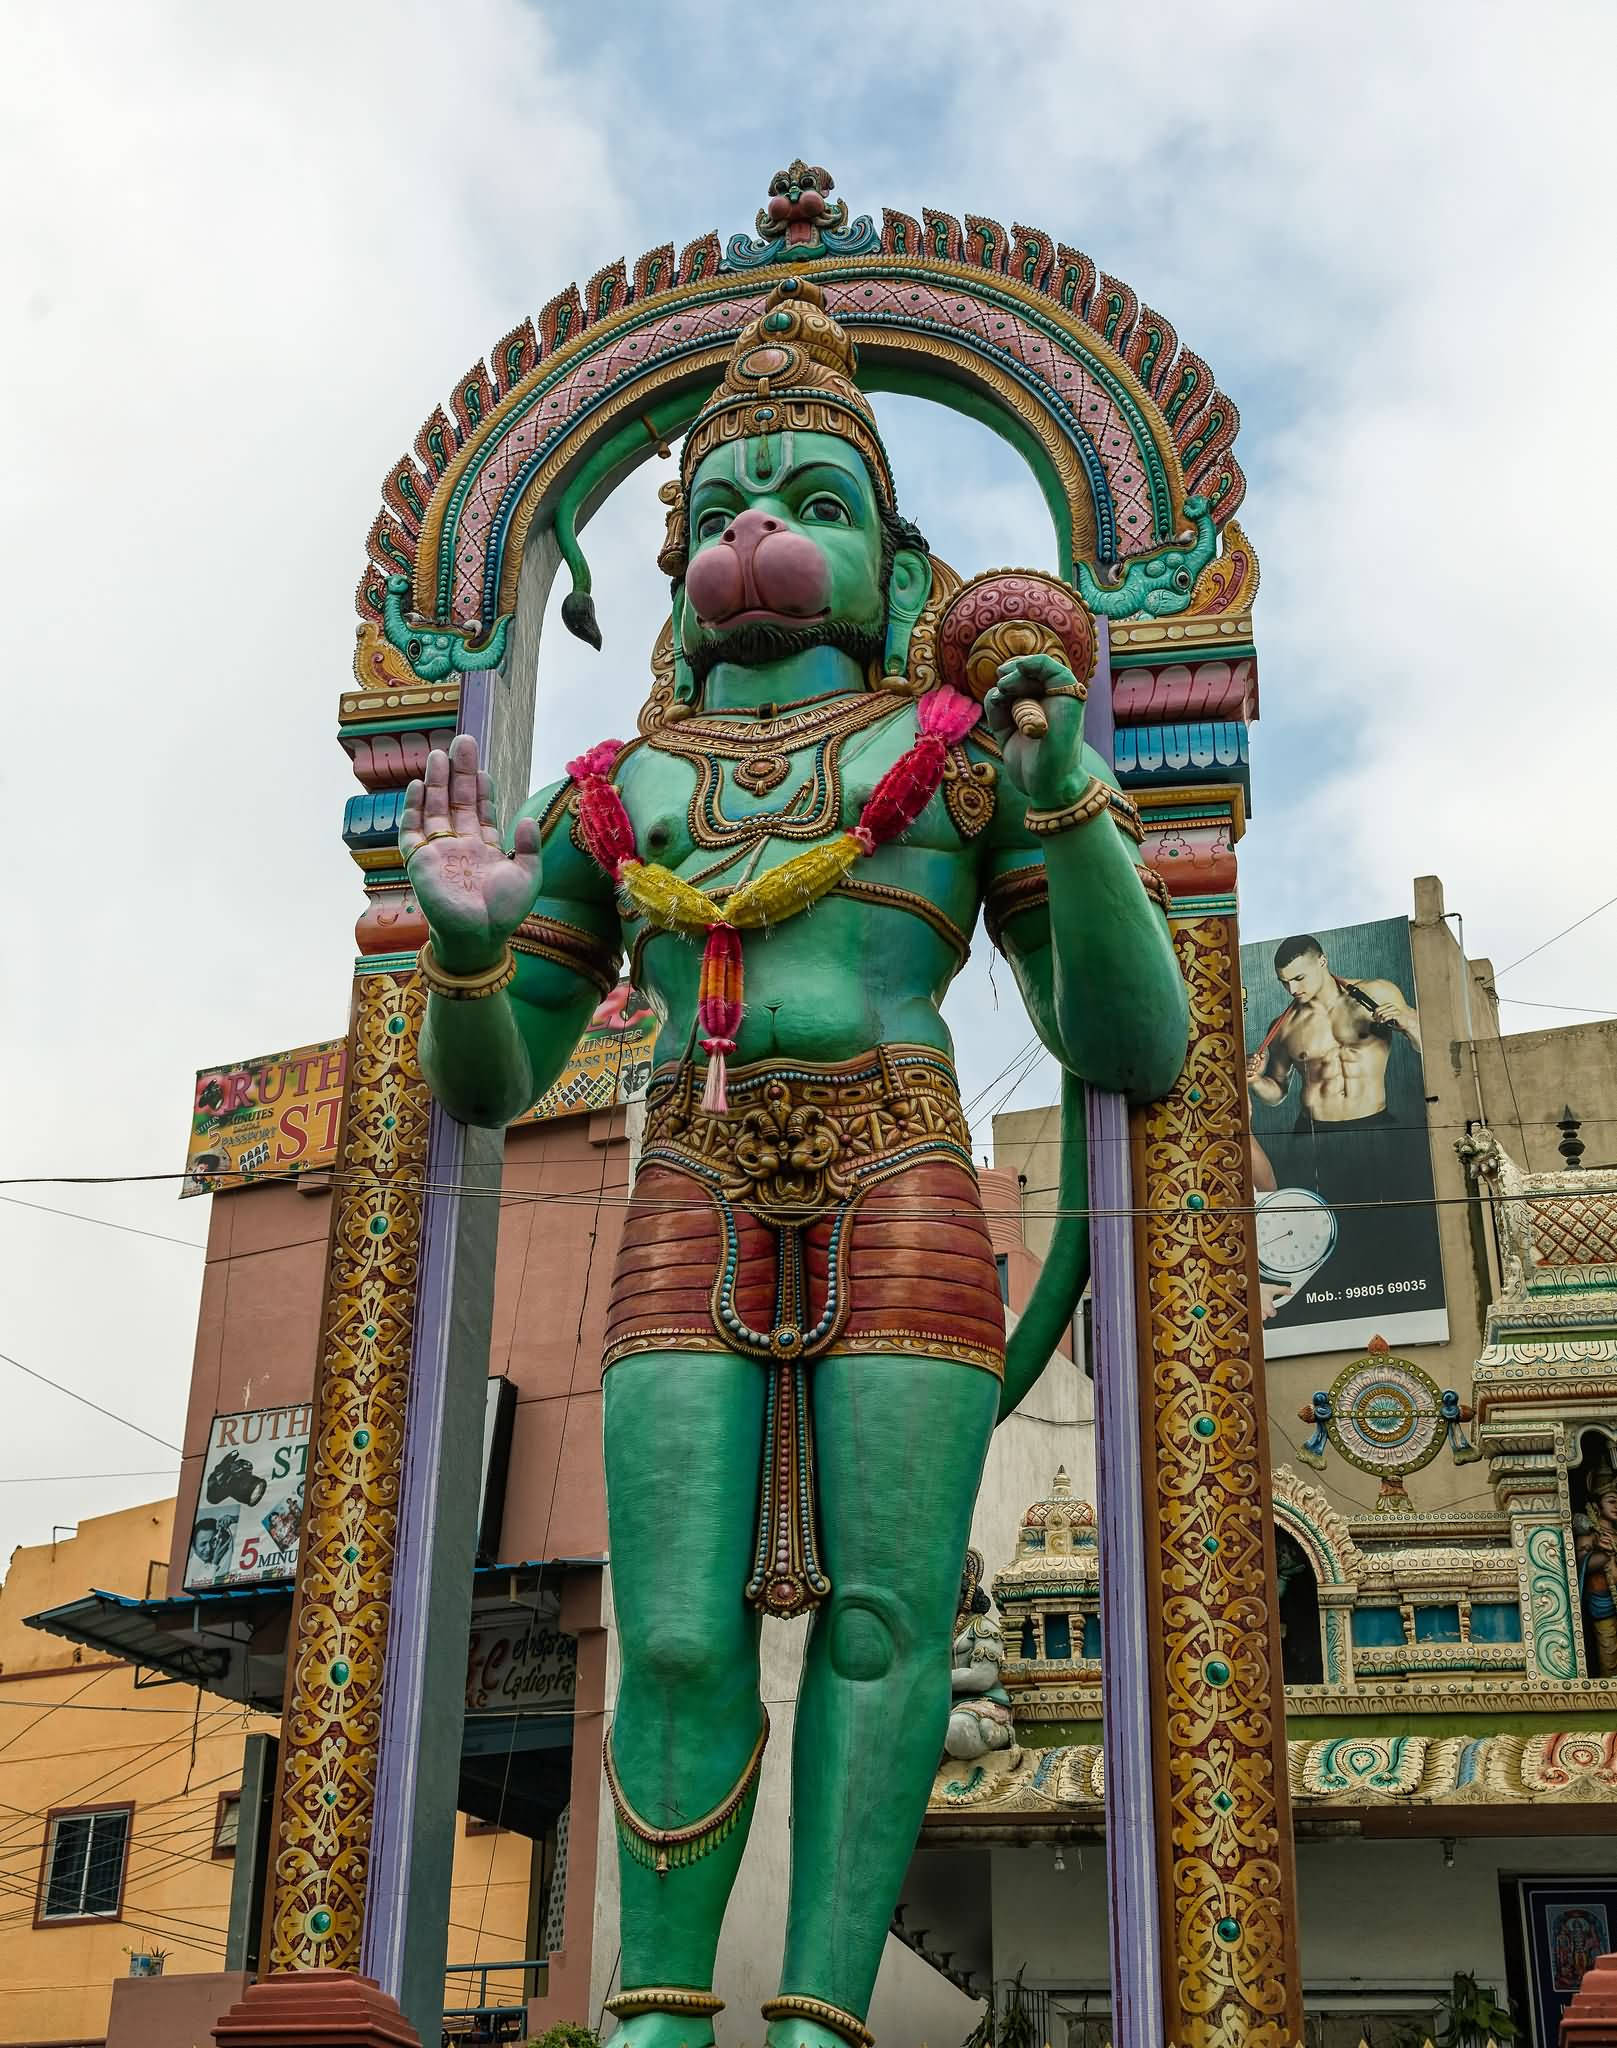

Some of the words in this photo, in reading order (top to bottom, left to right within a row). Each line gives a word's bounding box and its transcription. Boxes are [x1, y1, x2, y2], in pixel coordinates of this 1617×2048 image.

[574, 1029, 644, 1055] MINUTES
[567, 1054, 600, 1070] PASS
[1305, 1289, 1342, 1304] Mob.:
[1345, 1284, 1384, 1299] 99805
[1387, 1279, 1427, 1295] 69035
[239, 1537, 260, 1570] 5
